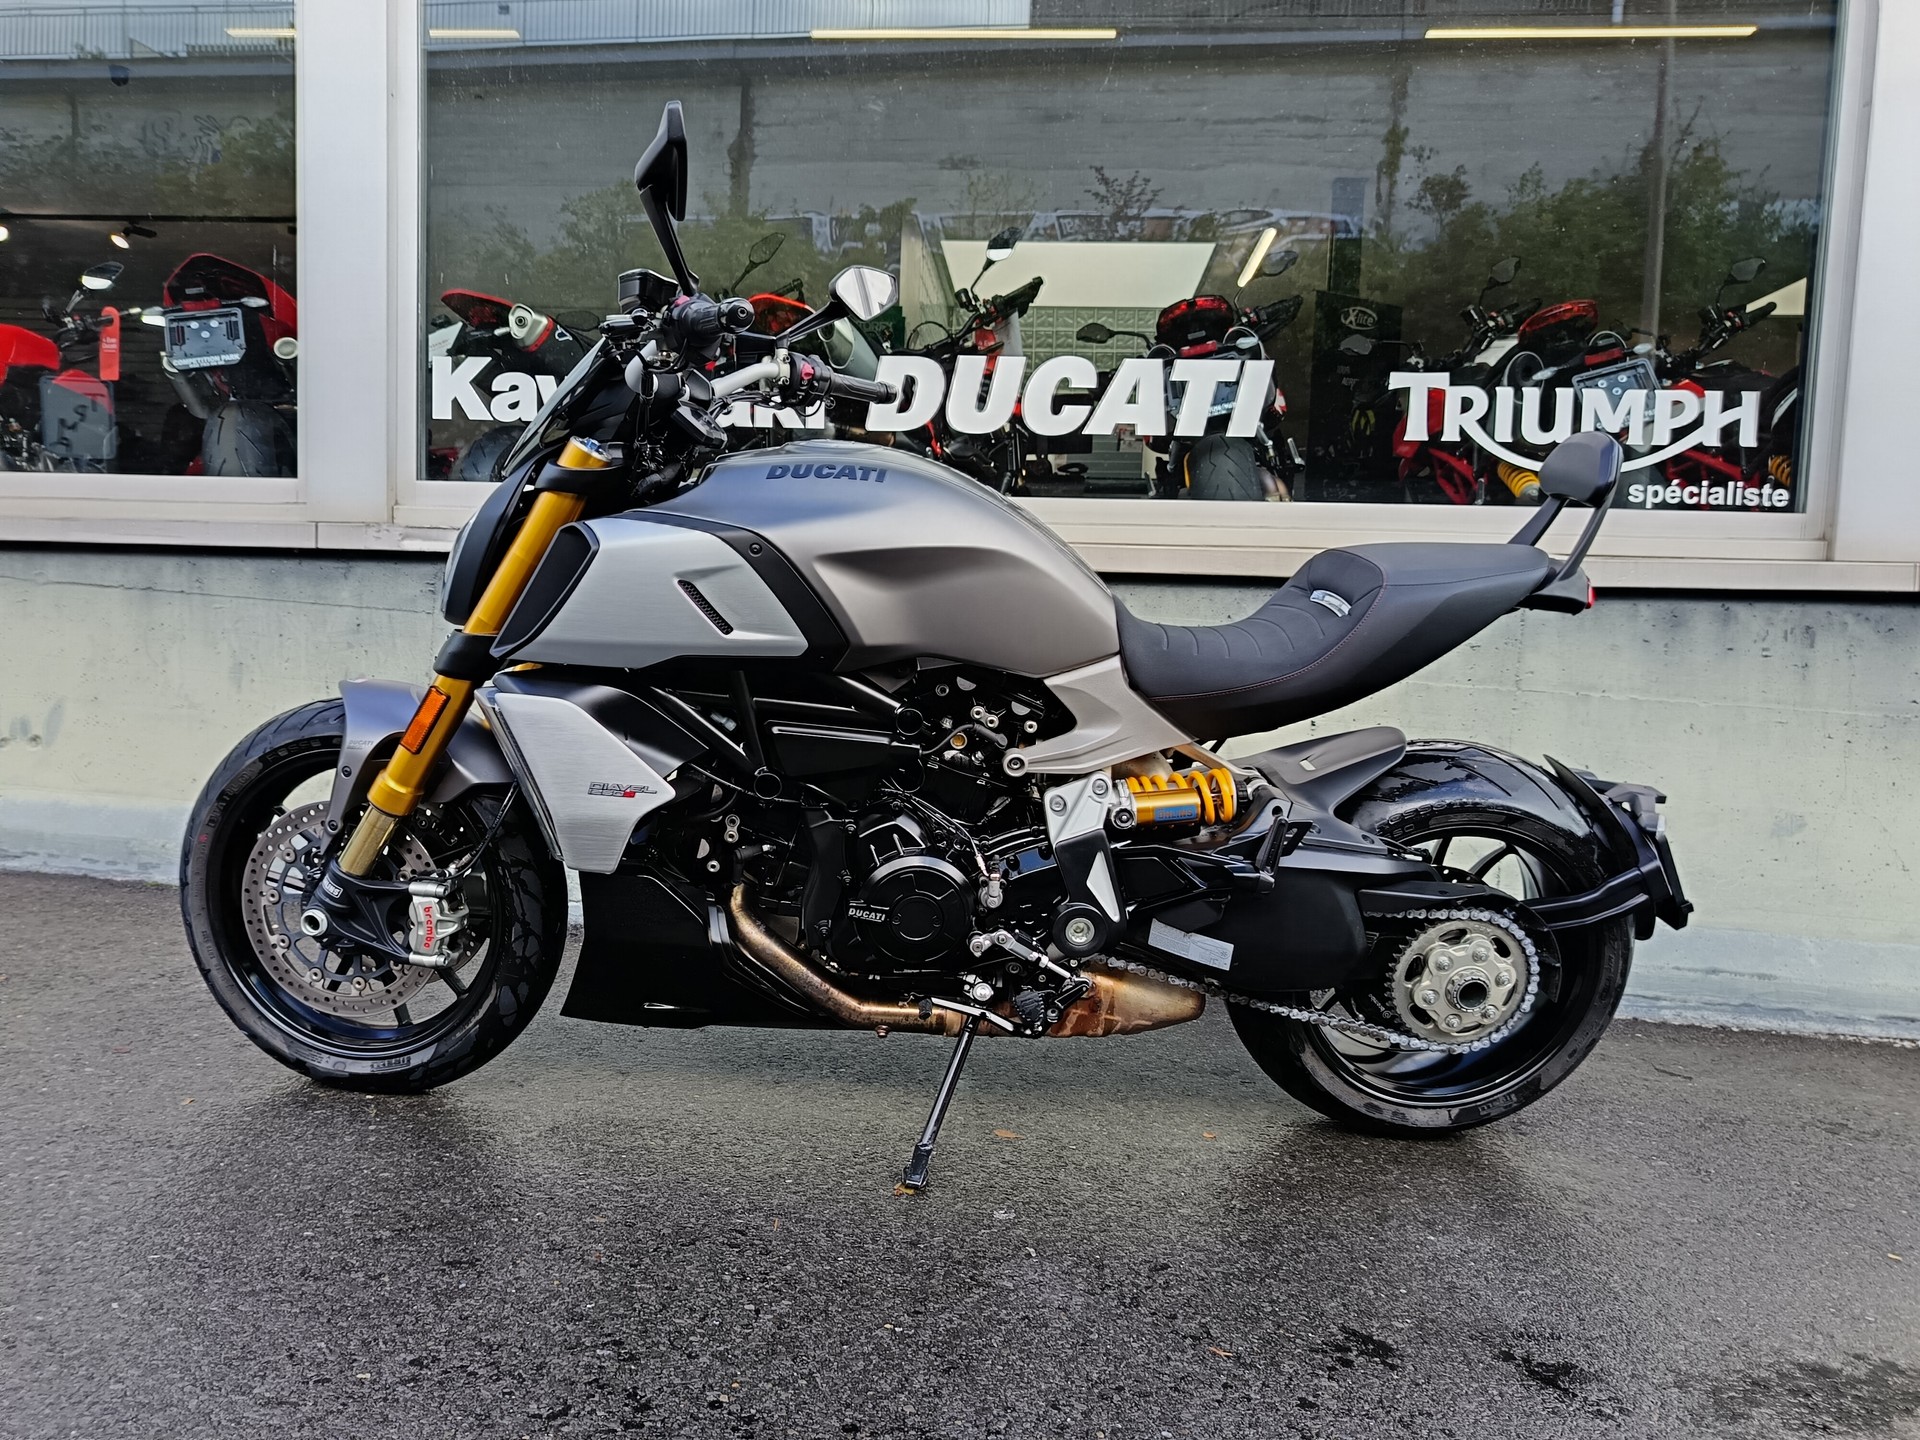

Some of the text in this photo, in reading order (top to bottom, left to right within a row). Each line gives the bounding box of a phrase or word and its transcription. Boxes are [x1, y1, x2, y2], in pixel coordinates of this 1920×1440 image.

[865, 355, 1275, 438] DUCATI
[1388, 371, 1761, 472] TRIUMPH
[766, 464, 887, 483] DUCATI
[1627, 480, 1790, 508] spécialiste
[589, 781, 658, 795] DIAVEL
[423, 906, 434, 949] brembo
[848, 907, 886, 921] DUCATI
